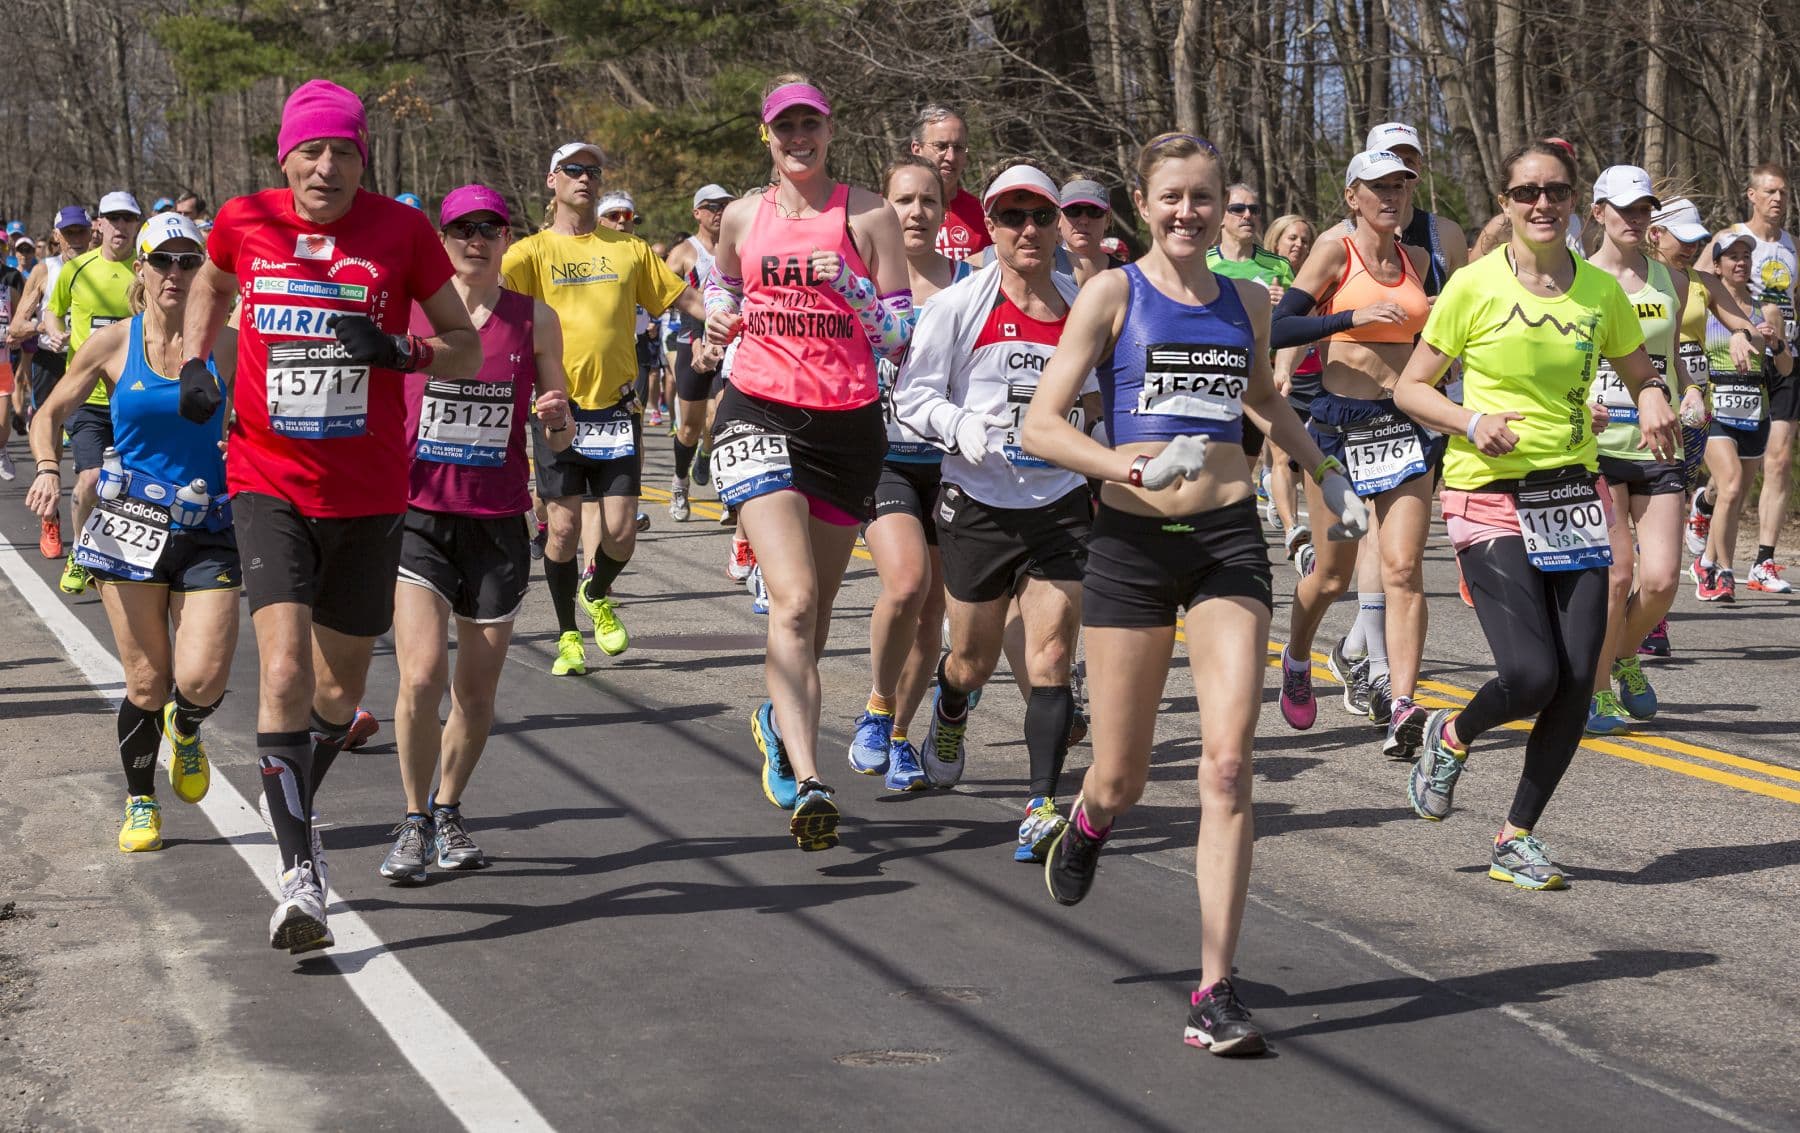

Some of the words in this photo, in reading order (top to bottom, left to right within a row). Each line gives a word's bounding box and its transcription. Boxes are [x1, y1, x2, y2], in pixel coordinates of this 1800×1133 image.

[551, 262, 592, 280] NRC
[340, 287, 363, 298] Banca
[748, 311, 854, 339] BOSTONSTRONG
[308, 344, 352, 359] adid
[1191, 349, 1246, 368] adidas
[272, 368, 367, 396] 15717
[462, 384, 512, 398] adidas
[1597, 394, 1603, 405] 6
[1716, 395, 1760, 410] 15969
[271, 401, 279, 414] 7
[427, 400, 509, 429] 15122
[422, 425, 430, 438] 7
[576, 421, 630, 436] 12778
[1374, 422, 1412, 438] adidas
[1006, 432, 1015, 445] 5
[713, 437, 783, 472] 13345
[1350, 437, 1416, 467] 15767
[1352, 470, 1359, 480] 7
[715, 477, 724, 490] 5
[1550, 483, 1594, 500] adidas
[123, 502, 169, 524] adidas
[1524, 503, 1603, 534] 11900
[82, 533, 90, 546] 8
[91, 512, 162, 552] 16225
[1528, 538, 1537, 552] 3
